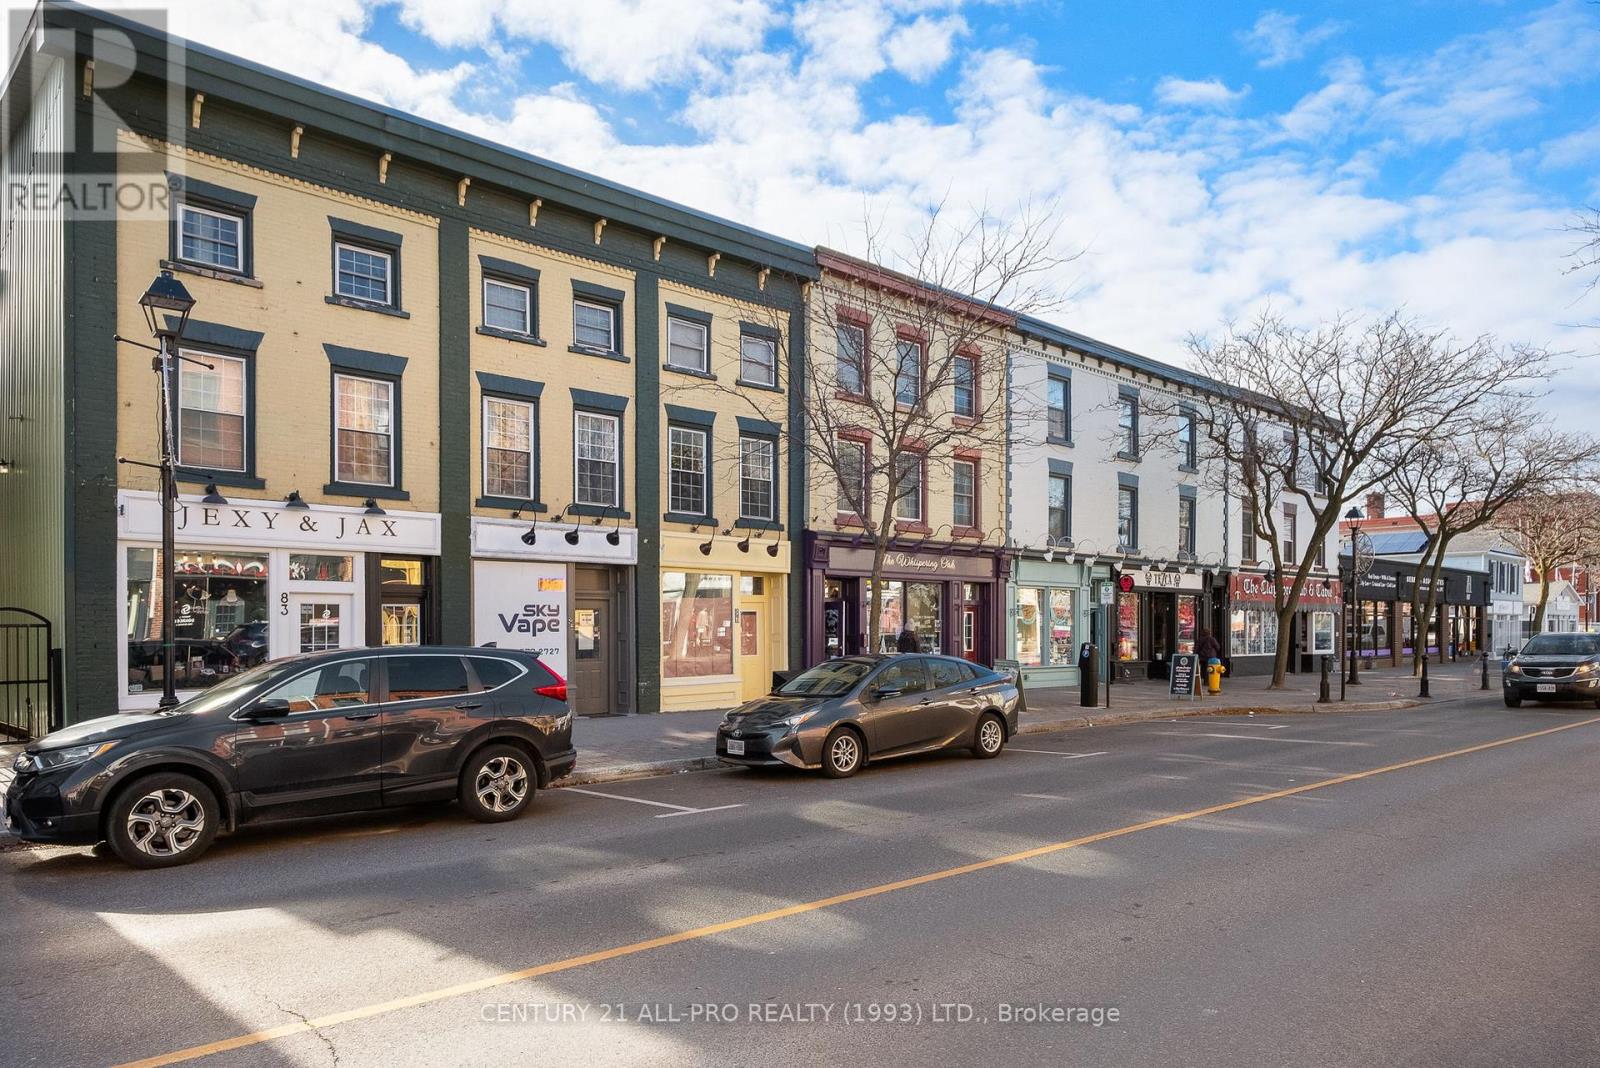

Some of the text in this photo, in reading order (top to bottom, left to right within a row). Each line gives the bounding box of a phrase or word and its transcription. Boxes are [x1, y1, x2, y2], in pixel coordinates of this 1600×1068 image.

[177, 506, 398, 539] JEXY & JAX
[882, 553, 956, 573] The Whispering Oak
[1243, 578, 1259, 594] The
[1309, 583, 1314, 597] &
[281, 592, 289, 616] 83
[498, 613, 560, 637] Vape
